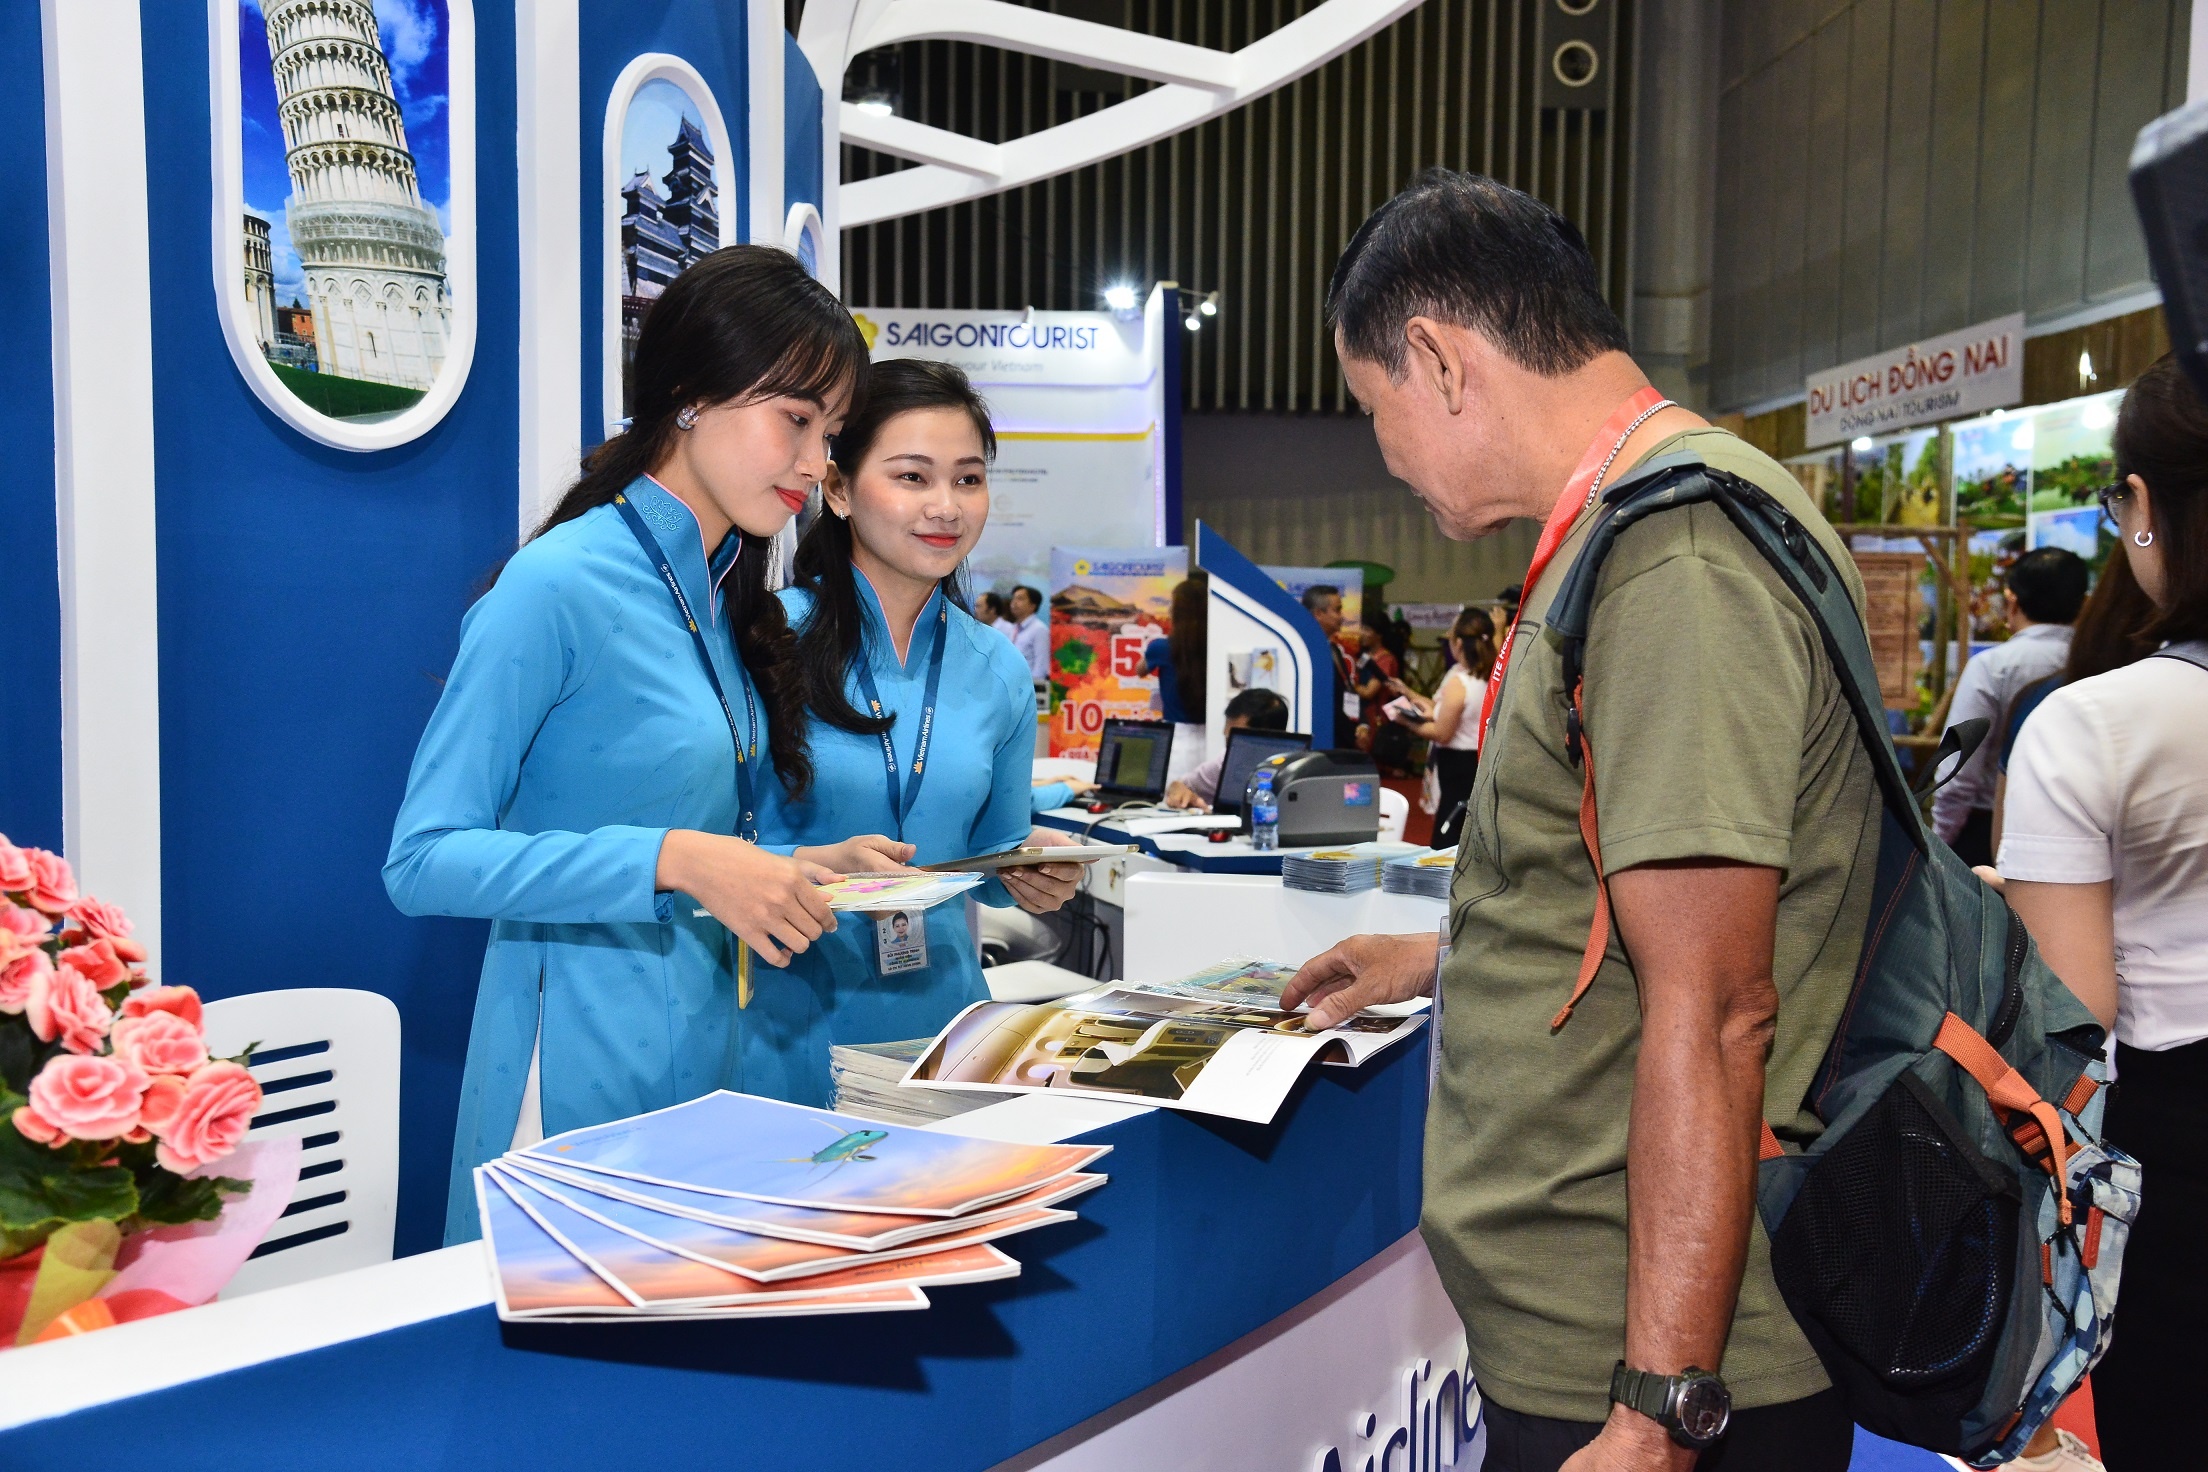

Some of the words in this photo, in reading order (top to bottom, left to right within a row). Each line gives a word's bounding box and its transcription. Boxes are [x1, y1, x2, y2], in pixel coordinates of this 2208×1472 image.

[886, 322, 1098, 349] SAIGONTOURIST
[990, 358, 1044, 372] Vietnam
[1810, 384, 1834, 416] DU
[1964, 334, 2009, 378] NAI
[1493, 661, 1502, 682] ITE
[1063, 703, 1103, 732] 10
[1318, 1345, 1482, 1472] irline
